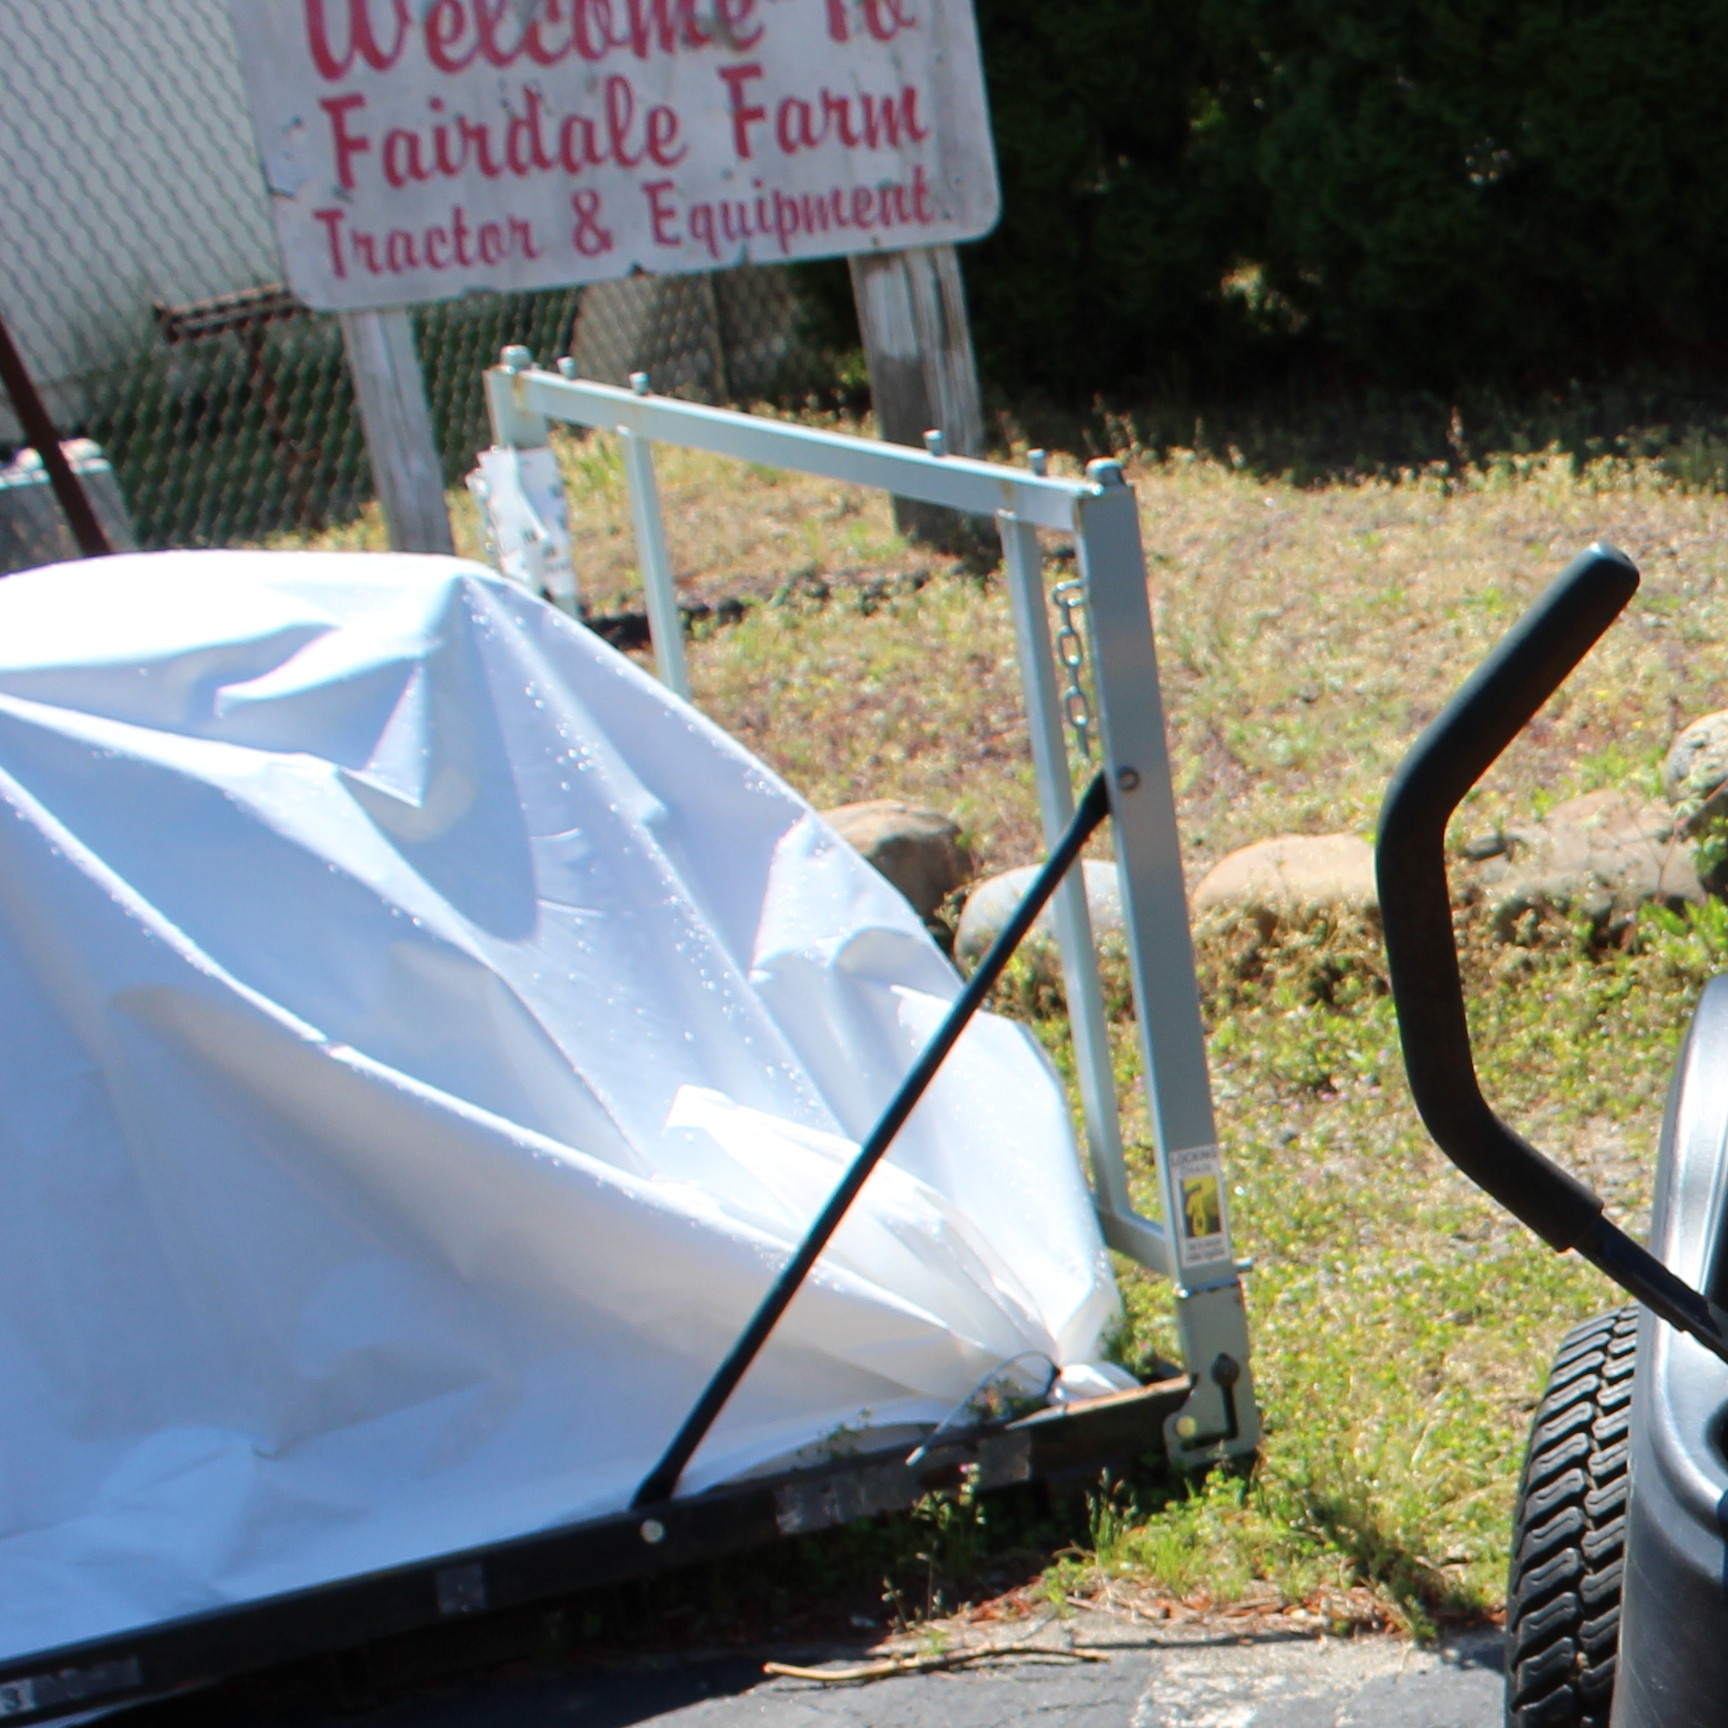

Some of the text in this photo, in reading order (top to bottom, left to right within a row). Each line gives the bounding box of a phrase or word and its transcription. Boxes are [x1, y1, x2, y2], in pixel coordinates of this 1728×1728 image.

[308, 0, 764, 81] Welcome
[320, 65, 929, 189] Fairdale Farm
[315, 166, 934, 279] Tractor & Equipment
